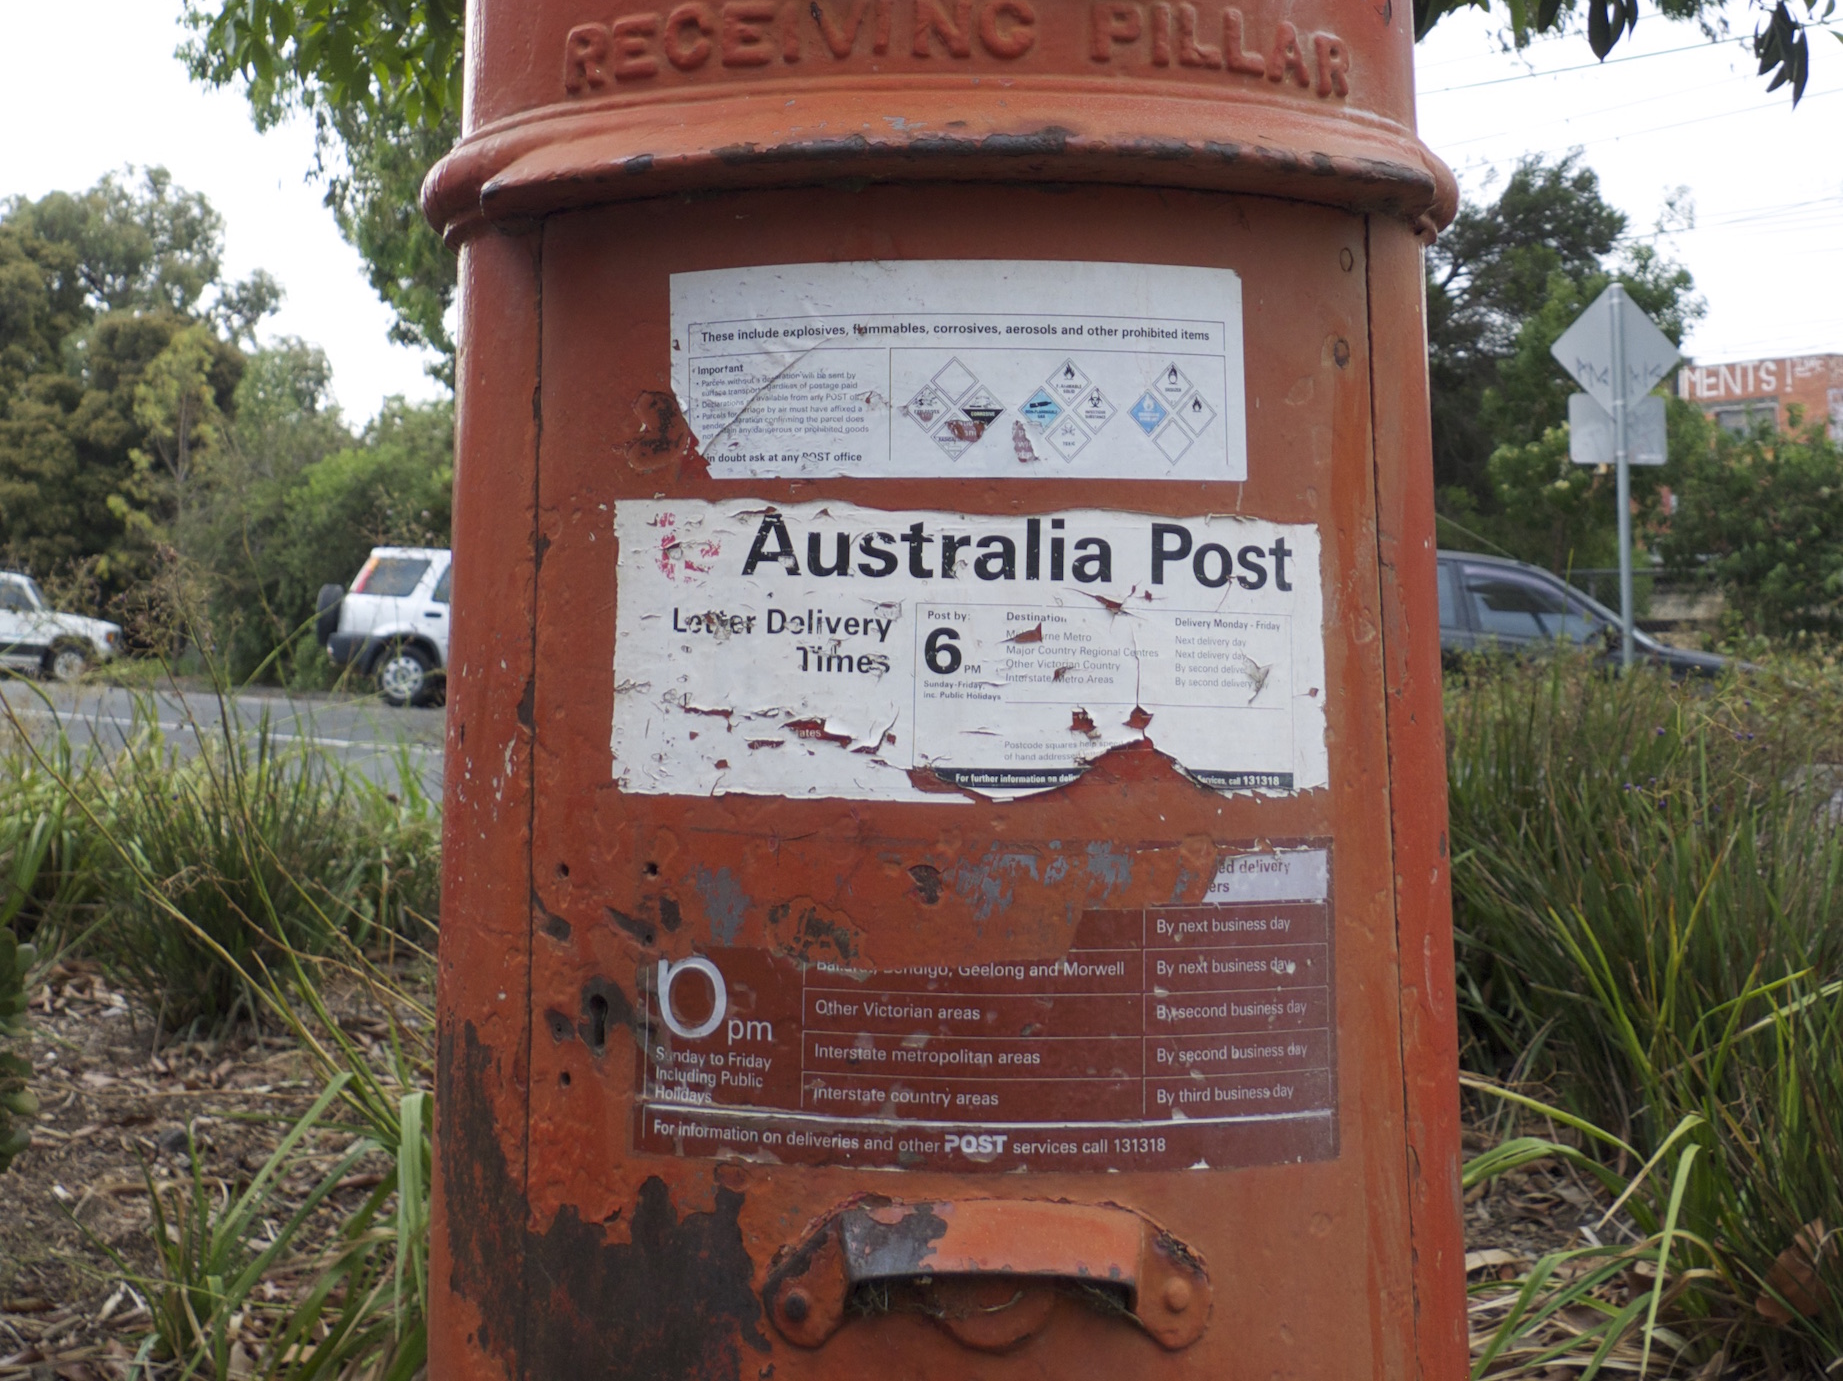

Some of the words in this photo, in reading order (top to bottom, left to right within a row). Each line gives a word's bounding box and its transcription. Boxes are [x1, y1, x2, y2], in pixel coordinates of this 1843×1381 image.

[1090, 0, 1350, 98] PILLAR
[701, 331, 734, 343] These
[738, 328, 779, 340] include
[783, 325, 849, 339] explosives,
[933, 322, 1001, 335] corrosives,
[1006, 323, 1057, 335] aerosols
[1061, 325, 1083, 336] and
[1087, 325, 1118, 337] other
[1122, 327, 1178, 340] prohibited
[1181, 329, 1209, 341] items
[697, 364, 744, 377] Important
[816, 371, 827, 379] be
[846, 372, 856, 381] by
[809, 383, 840, 392] postage
[841, 382, 858, 391] paid
[766, 406, 776, 414] by
[789, 405, 808, 413] must
[810, 405, 828, 413] have
[830, 405, 856, 413] affixed
[820, 415, 843, 424] parcel
[846, 415, 864, 423] does
[794, 426, 802, 434] or
[804, 425, 843, 435] prohibited
[844, 425, 869, 435] goods
[718, 452, 746, 463] doubt
[749, 452, 766, 462] ask
[768, 453, 779, 462] at
[781, 454, 800, 464] any
[833, 451, 863, 462] office
[741, 513, 1112, 583] Australia
[1152, 522, 1293, 592] Post
[927, 610, 951, 621] Post
[954, 610, 971, 622] by:
[1006, 611, 1068, 623] Destination
[767, 607, 893, 643] Delivery
[1175, 618, 1211, 630] Delivery
[1213, 619, 1248, 630] Monday
[1256, 620, 1281, 632] Friday
[1063, 632, 1092, 642] Metro
[1175, 635, 1195, 645] Next
[1197, 636, 1230, 647] delivery
[1232, 637, 1246, 648] day
[924, 627, 963, 675] 6
[964, 664, 982, 674] PM
[1006, 645, 1035, 656] Major
[1038, 646, 1077, 657] Country
[1080, 646, 1121, 658] Regional
[1123, 648, 1159, 658] Centres
[1175, 649, 1195, 659] Next
[1197, 650, 1230, 661] delivery
[796, 645, 891, 674] Times
[1005, 658, 1033, 669] Other
[1037, 659, 1080, 670] Victorian
[1083, 660, 1121, 672] Country
[1175, 663, 1186, 673] By
[1188, 664, 1219, 673] second
[1221, 664, 1246, 674] delive
[1087, 674, 1114, 685] Areas
[1175, 677, 1186, 687] By
[1188, 677, 1219, 687] second
[1221, 678, 1253, 690] delivery
[940, 691, 964, 700] Public
[966, 691, 1002, 702] Holidays
[1004, 740, 1044, 750] Postcode
[1045, 741, 1077, 751] squares
[1004, 753, 1013, 761] of
[1015, 752, 1038, 761] hand
[955, 773, 969, 784] For
[971, 773, 998, 784] further
[1000, 774, 1047, 784] information
[1228, 776, 1241, 785] call
[1243, 775, 1280, 786] 131318
[1218, 860, 1235, 874] ed
[1239, 858, 1291, 875] delivery
[1209, 881, 1230, 893] ers
[1156, 918, 1174, 935] By
[1178, 920, 1208, 932] next
[1212, 916, 1266, 932] business
[1270, 916, 1291, 932] day
[958, 964, 1024, 980] Geelong
[1029, 962, 1058, 977] and
[1063, 961, 1124, 976] Morwell
[1156, 960, 1174, 977] By
[1178, 961, 1208, 974] next
[1212, 958, 1266, 974] business
[1270, 957, 1291, 973] day
[815, 999, 859, 1016] Other
[863, 1001, 933, 1018] Victorian
[938, 1005, 981, 1020] areas
[1156, 1004, 1173, 1021] By
[1178, 1002, 1227, 1018] second
[1231, 1002, 1284, 1017] business
[1286, 1000, 1307, 1016] day
[728, 1020, 772, 1046] pm
[814, 1043, 887, 1061] Interstate
[892, 1048, 993, 1066] metropolitan
[998, 1051, 1041, 1065] areas
[1156, 1047, 1174, 1065] By
[1178, 1046, 1228, 1062] second
[1231, 1044, 1284, 1060] business
[1287, 1042, 1308, 1058] day
[710, 1051, 724, 1065] to
[728, 1051, 772, 1071] Friday
[655, 1066, 716, 1087] Including
[721, 1070, 764, 1088] Public
[655, 1086, 712, 1103] Holidays
[890, 1087, 951, 1108] country
[956, 1091, 999, 1107] areas
[1156, 1088, 1174, 1106] By
[1179, 1087, 1211, 1104] third
[1214, 1085, 1268, 1101] business
[1272, 1084, 1294, 1099] day
[653, 1119, 674, 1136] For
[677, 1120, 759, 1144] information
[763, 1130, 782, 1145] on
[787, 1131, 859, 1150] deliveries
[863, 1136, 894, 1152] and
[898, 1138, 941, 1154] other
[944, 1134, 1008, 1154] POST
[1013, 1139, 1078, 1155] services
[1082, 1137, 1109, 1155] call
[1114, 1137, 1166, 1154] 131318
